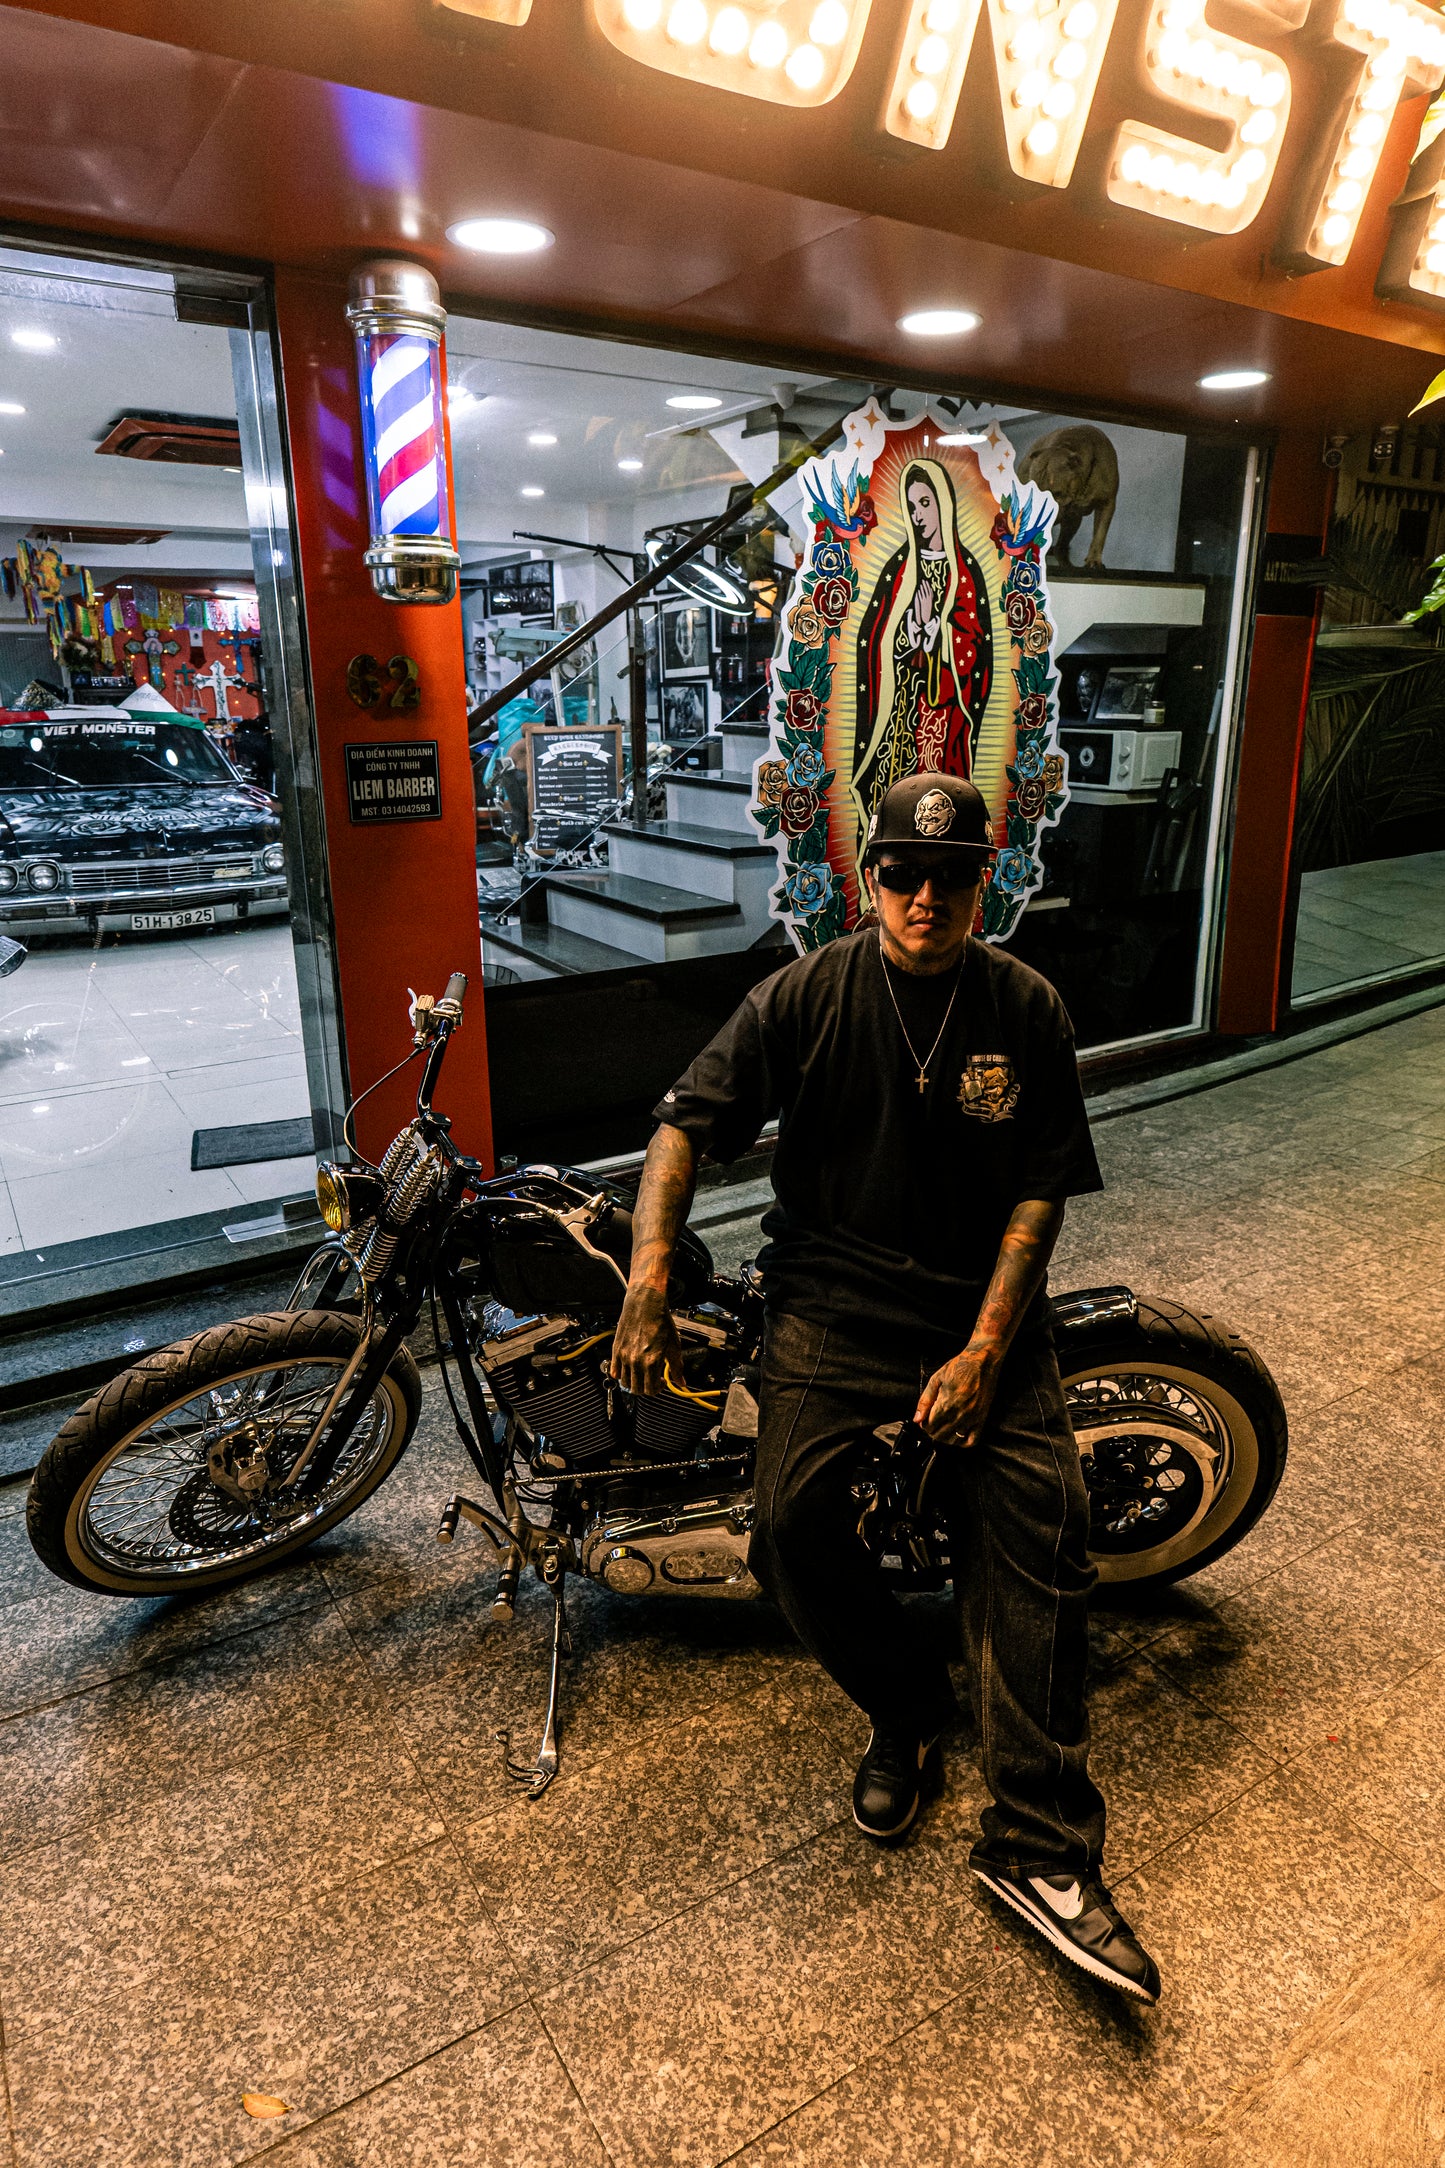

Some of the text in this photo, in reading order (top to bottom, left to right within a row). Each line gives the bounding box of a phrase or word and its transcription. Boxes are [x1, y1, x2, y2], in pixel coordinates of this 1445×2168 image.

[43, 724, 156, 737] VIET MONSTER
[387, 748, 406, 758] KINH
[407, 747, 433, 757] DOANH
[388, 762, 398, 771] TY
[399, 761, 421, 770] TNHH
[353, 776, 436, 801] LIEM BARBER
[381, 803, 431, 815] 0314042593
